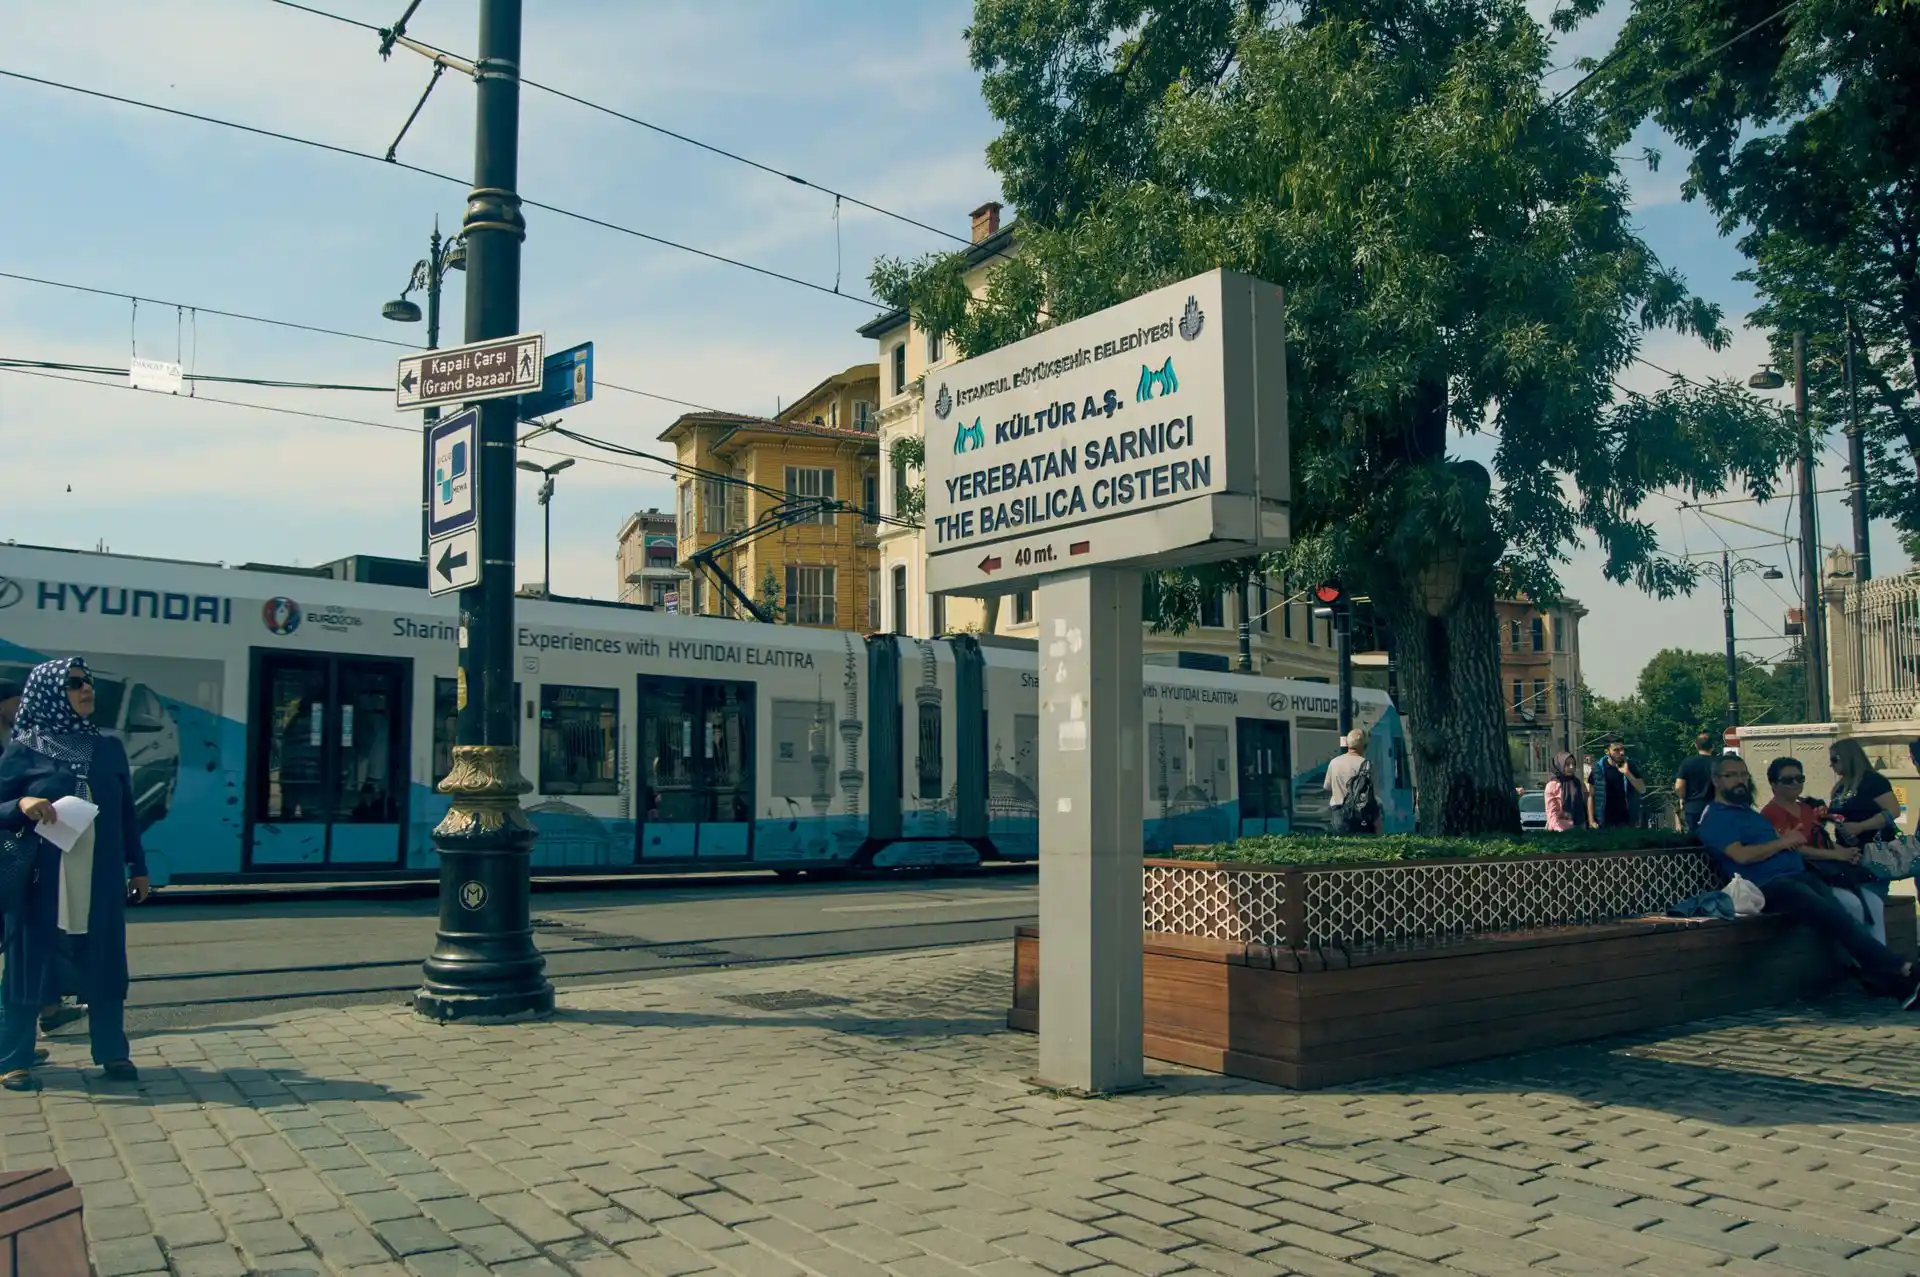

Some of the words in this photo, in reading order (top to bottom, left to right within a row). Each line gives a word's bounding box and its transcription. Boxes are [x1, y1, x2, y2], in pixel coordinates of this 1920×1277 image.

[431, 355, 470, 375] Kapalı
[474, 351, 507, 372] Çarşı
[956, 376, 1012, 407] İSTANBUL
[1013, 348, 1092, 389] BÜYÜKŞEHİR
[1094, 317, 1174, 362] BELEDİYESİ
[422, 378, 462, 397] (Grand
[467, 367, 515, 388] Bazaar)
[995, 398, 1076, 444] KÜLTÜR
[1081, 389, 1124, 419] A.Ş.
[945, 446, 1077, 504] YEREBATAN
[1084, 415, 1194, 470] SARNICI
[934, 510, 974, 543] THE
[980, 485, 1086, 534] BASILICA
[1092, 456, 1211, 509] CISTERN
[1014, 548, 1032, 566] 40
[1034, 545, 1057, 564] mt.
[37, 581, 232, 625] HYUNDAI
[518, 628, 622, 654] Experiences
[625, 641, 660, 657] with
[668, 640, 741, 663] HYUNDAI
[746, 648, 814, 669] ELANTRA
[1020, 672, 1039, 688] Sha
[1161, 686, 1200, 701] HYUNDAI
[1201, 690, 1239, 705] ELANTRA
[1291, 695, 1338, 713] HYUNDA
